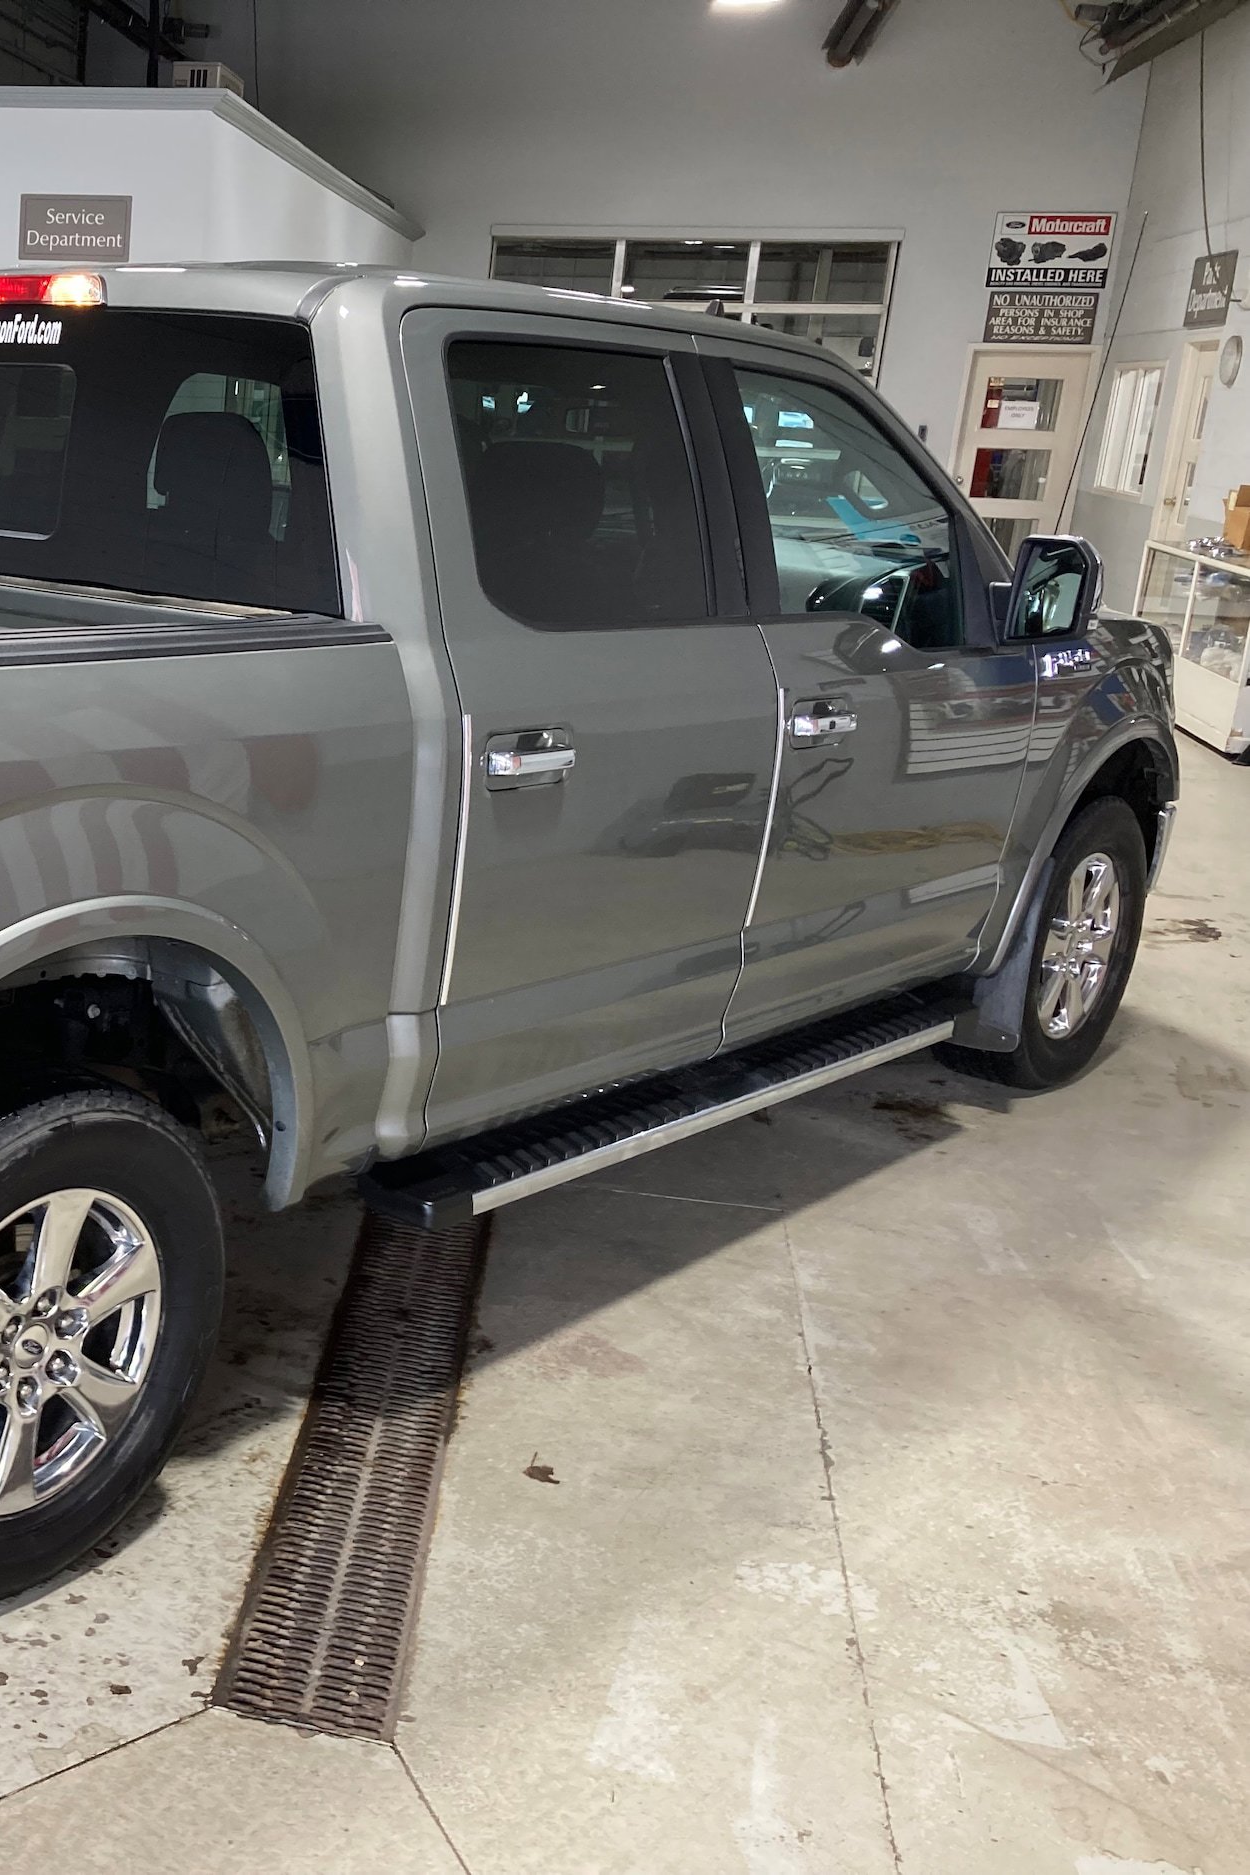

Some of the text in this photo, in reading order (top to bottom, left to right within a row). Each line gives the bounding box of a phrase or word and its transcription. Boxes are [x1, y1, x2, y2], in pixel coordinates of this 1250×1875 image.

[46, 207, 105, 225] Service
[1031, 218, 1107, 233] Motorcraft
[26, 229, 123, 251] Department
[990, 269, 1105, 283] INSTALLED HERE
[993, 294, 1095, 307] NO UNAUTHORIZED
[999, 308, 1085, 318] PERSONS IN SHOP
[989, 317, 1093, 327] AREA FOR INSURANCE
[993, 325, 1034, 335] REASONS
